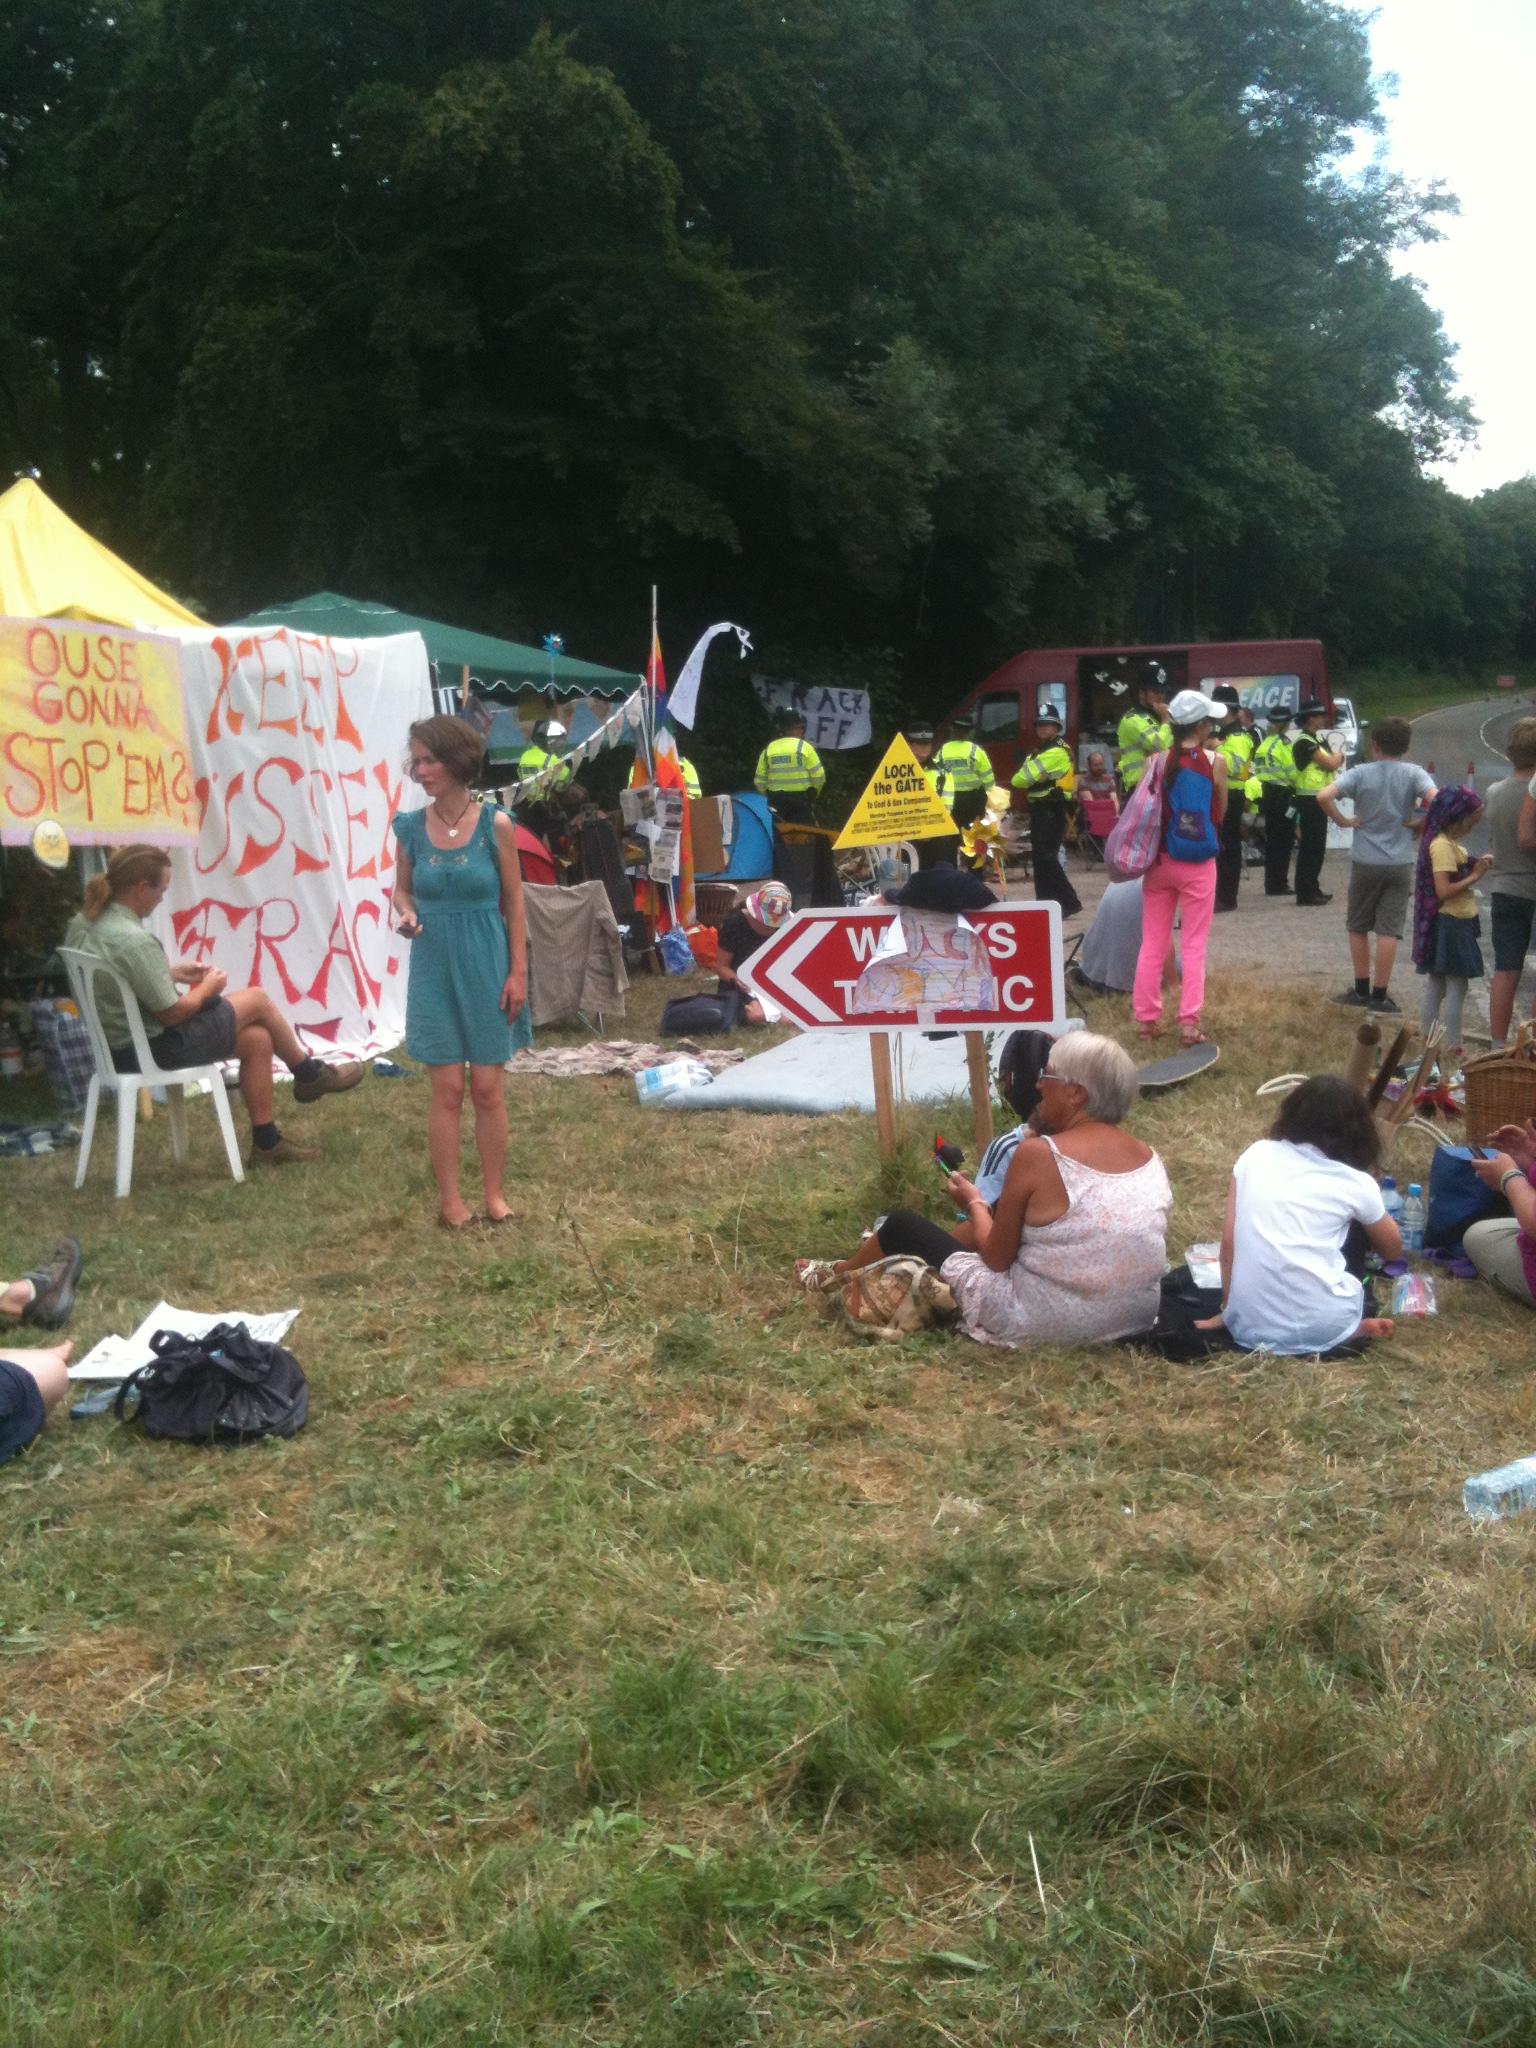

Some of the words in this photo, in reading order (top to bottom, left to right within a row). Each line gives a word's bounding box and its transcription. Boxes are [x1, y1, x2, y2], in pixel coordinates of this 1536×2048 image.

[26, 626, 139, 683] OUSE
[32, 680, 156, 731] GONNA
[206, 628, 363, 752] KEEP
[1239, 686, 1296, 709] EACE
[4, 731, 111, 823] STOP
[873, 782, 892, 796] the
[895, 777, 925, 793] GATE
[884, 763, 915, 779] LOCK
[194, 757, 404, 879] USSEX
